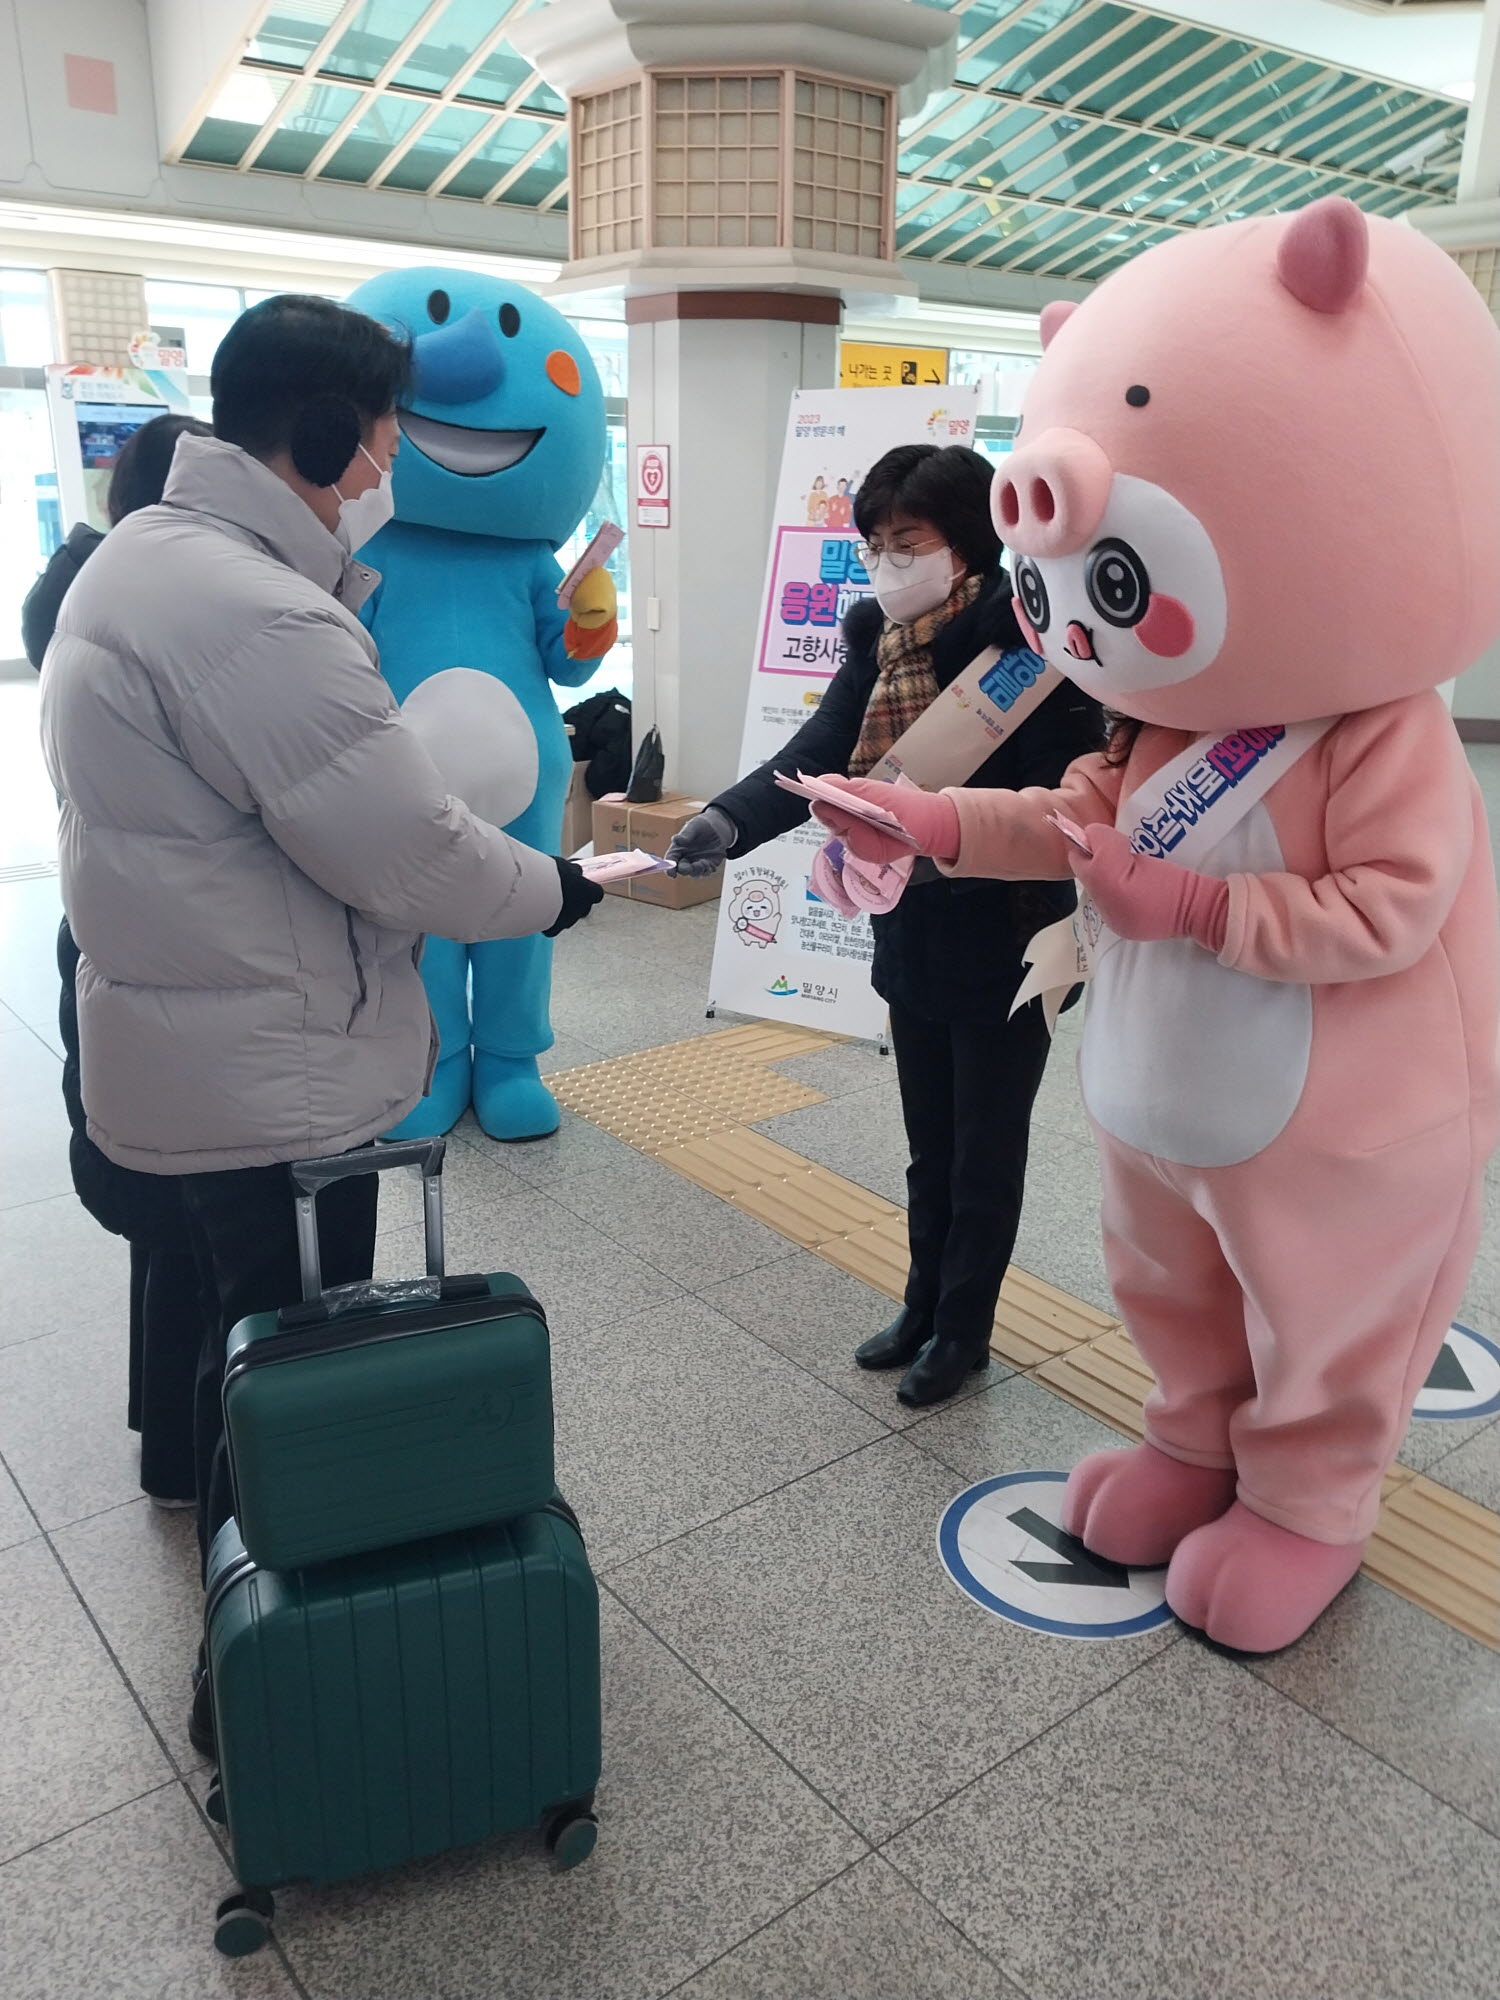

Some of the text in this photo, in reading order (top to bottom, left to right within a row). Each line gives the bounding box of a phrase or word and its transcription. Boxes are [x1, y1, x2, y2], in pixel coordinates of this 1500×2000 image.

[848, 363, 892, 381] 나가는 곳
[797, 414, 821, 424] 2023
[795, 426, 811, 438] 밀양
[837, 425, 845, 437] 해
[949, 420, 970, 436] 밀양
[781, 582, 876, 627] 응원해
[801, 993, 837, 1004] MIRYANG CITY
[802, 982, 838, 999] 밀양시
